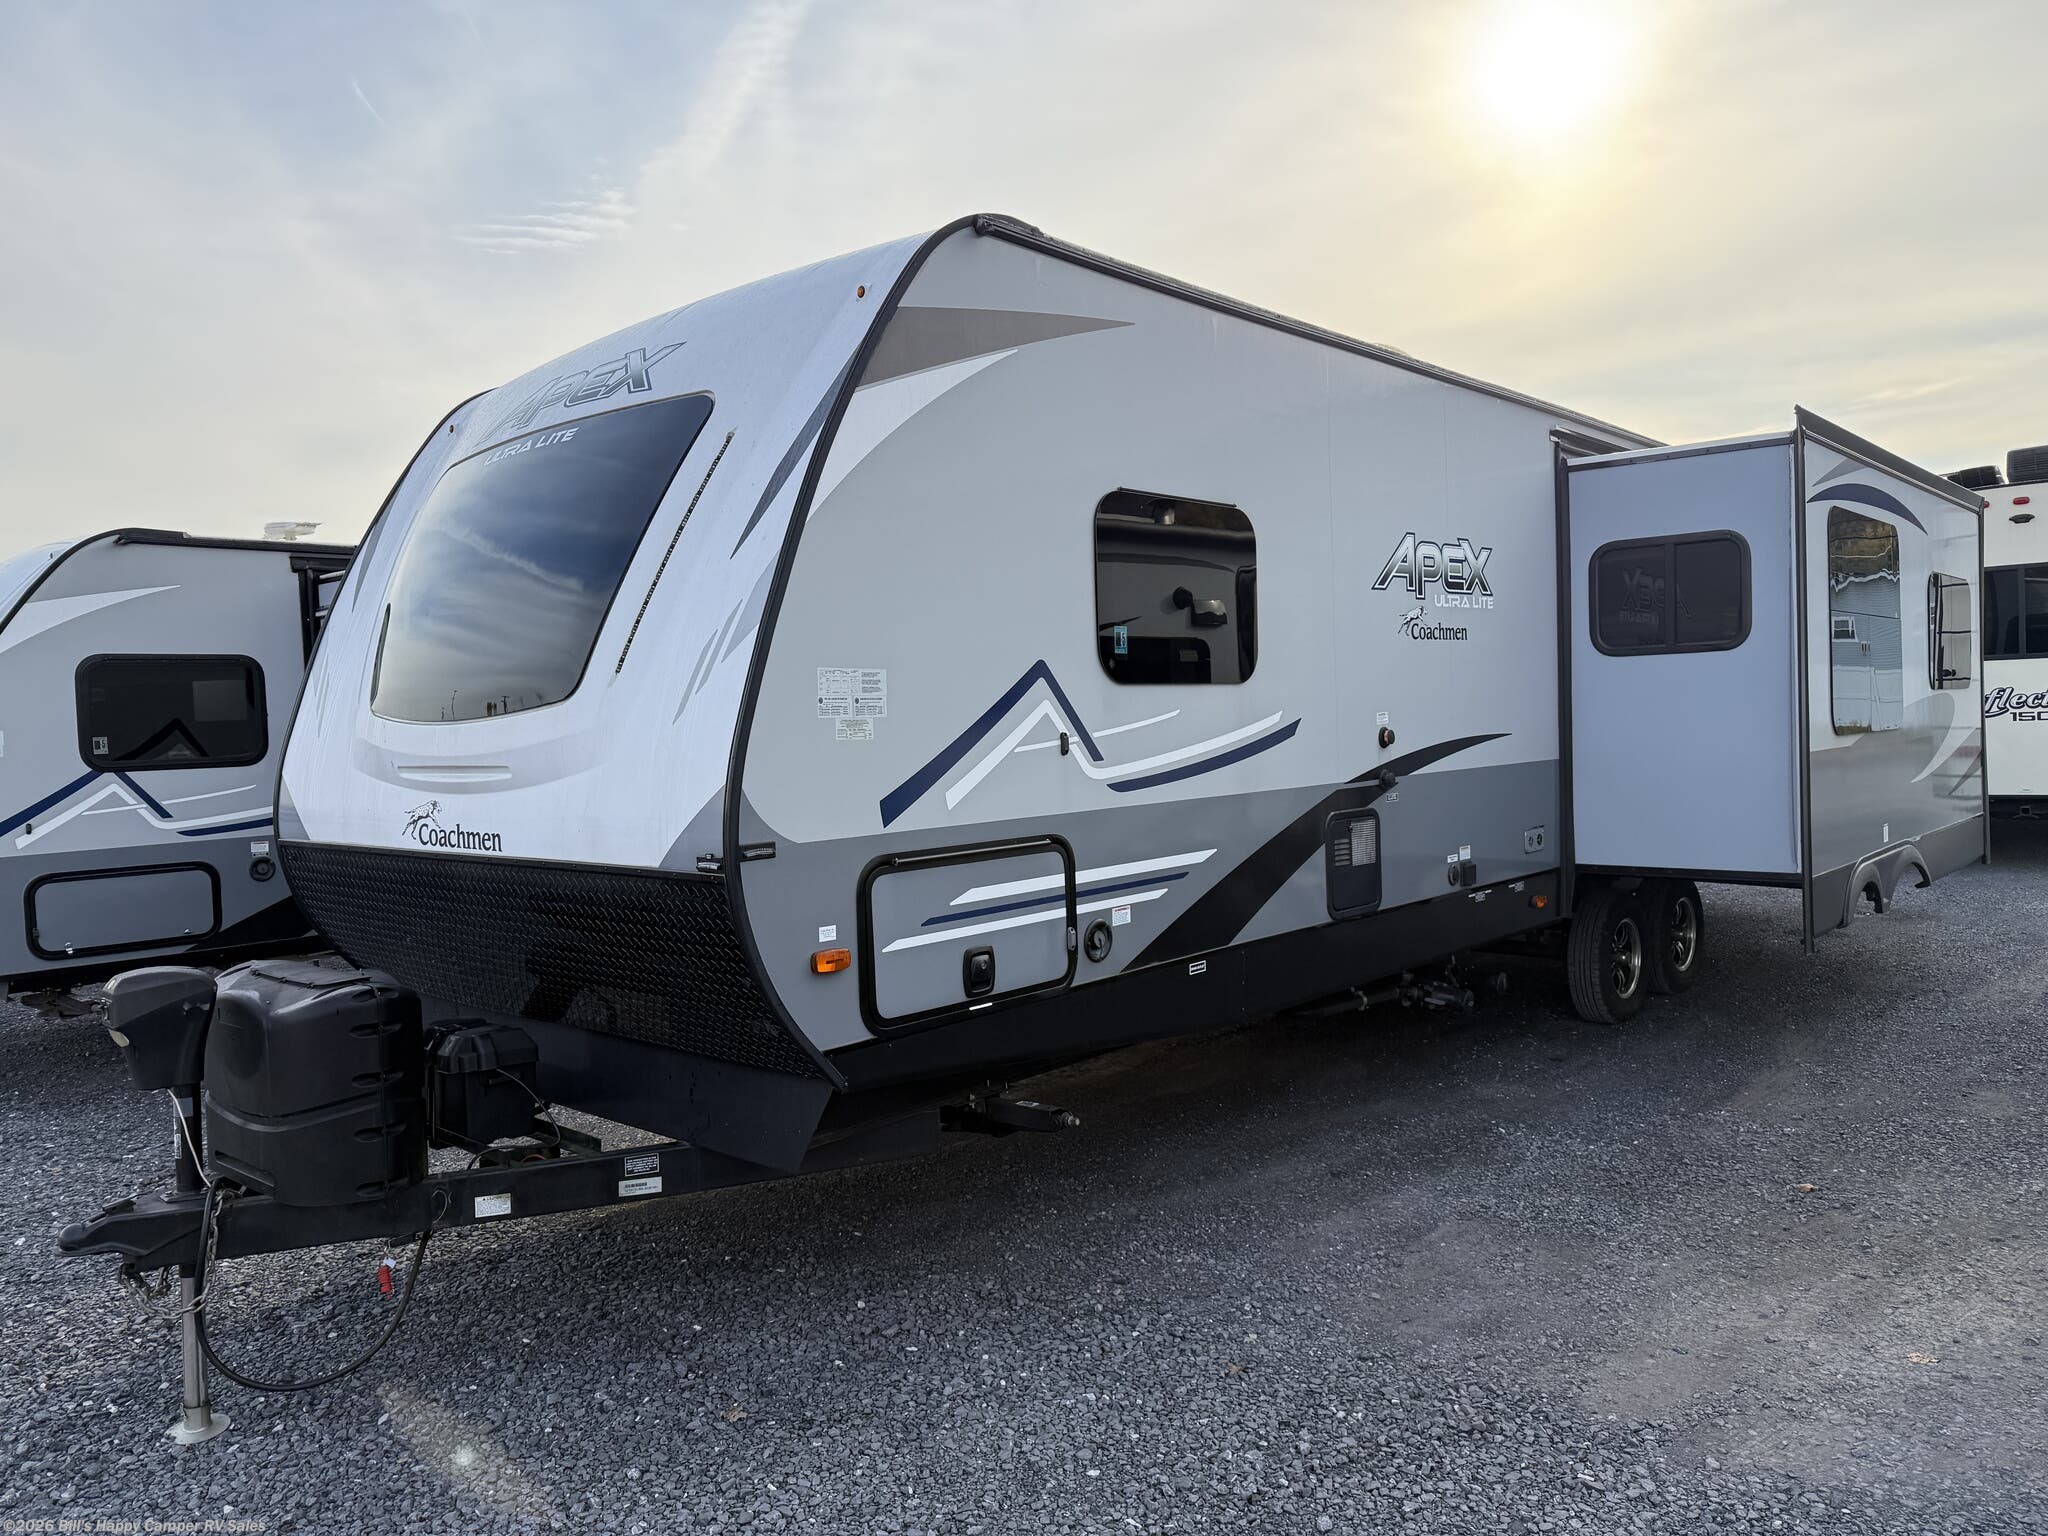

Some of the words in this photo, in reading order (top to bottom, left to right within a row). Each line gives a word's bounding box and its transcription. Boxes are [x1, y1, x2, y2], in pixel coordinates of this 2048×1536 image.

[476, 341, 687, 447] APEX
[483, 438, 532, 467] ULTRA
[535, 428, 579, 448] LITE
[1371, 531, 1494, 600] APEX
[1434, 594, 1470, 608] ULTRA
[1472, 596, 1494, 609] LITE
[1411, 622, 1468, 640] Coachmen
[419, 824, 502, 851] Coachmen
